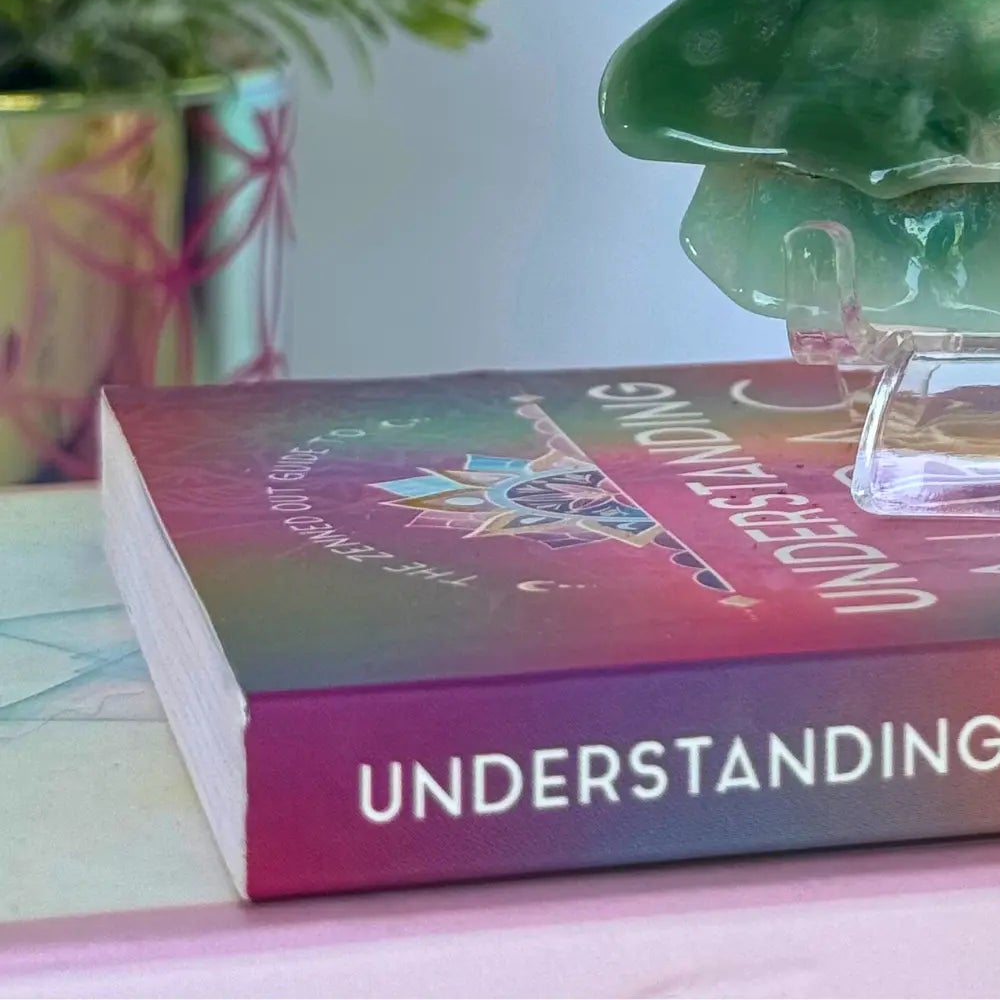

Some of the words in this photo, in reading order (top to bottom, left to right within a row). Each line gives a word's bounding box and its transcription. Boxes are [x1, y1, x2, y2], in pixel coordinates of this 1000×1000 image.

[308, 428, 367, 448] TO
[268, 446, 330, 482] GUIDE
[267, 486, 313, 512] OUT
[587, 381, 938, 614] UNDERSTANDING
[284, 516, 394, 562] ZENNED
[382, 562, 478, 587] THE
